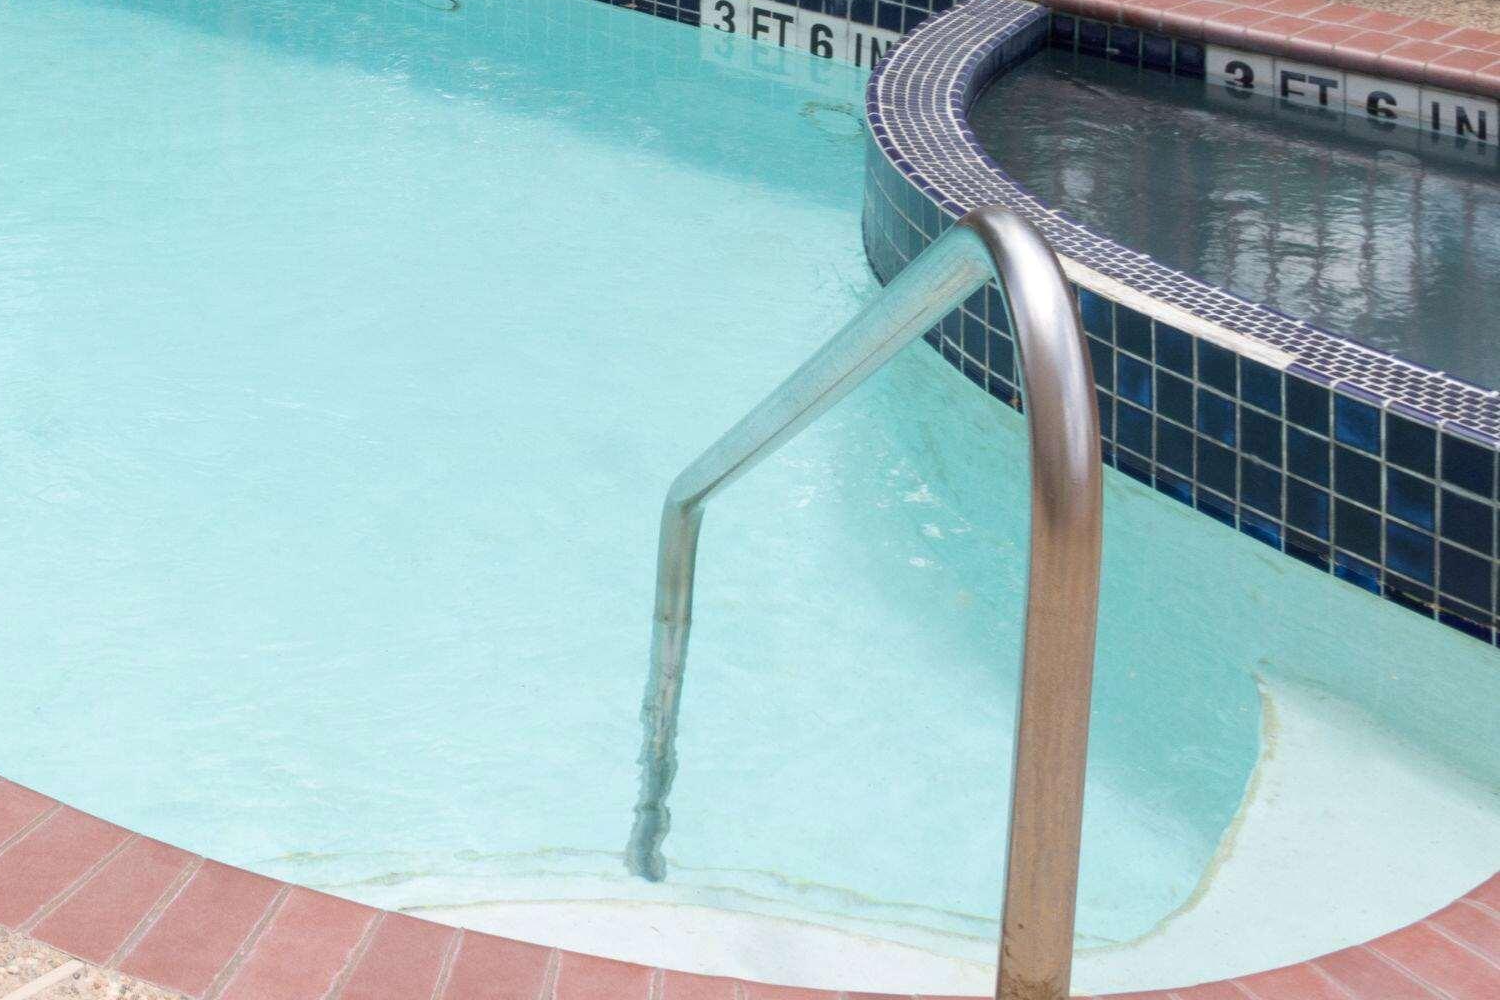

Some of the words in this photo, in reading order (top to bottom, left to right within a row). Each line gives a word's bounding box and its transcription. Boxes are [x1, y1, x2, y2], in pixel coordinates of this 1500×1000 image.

[713, 0, 736, 34] 3
[752, 7, 794, 47] FT
[810, 23, 833, 59] 6
[1225, 60, 1255, 89] 3
[1280, 70, 1338, 106] FT
[1367, 90, 1397, 119] 6
[1431, 101, 1487, 140] IN
